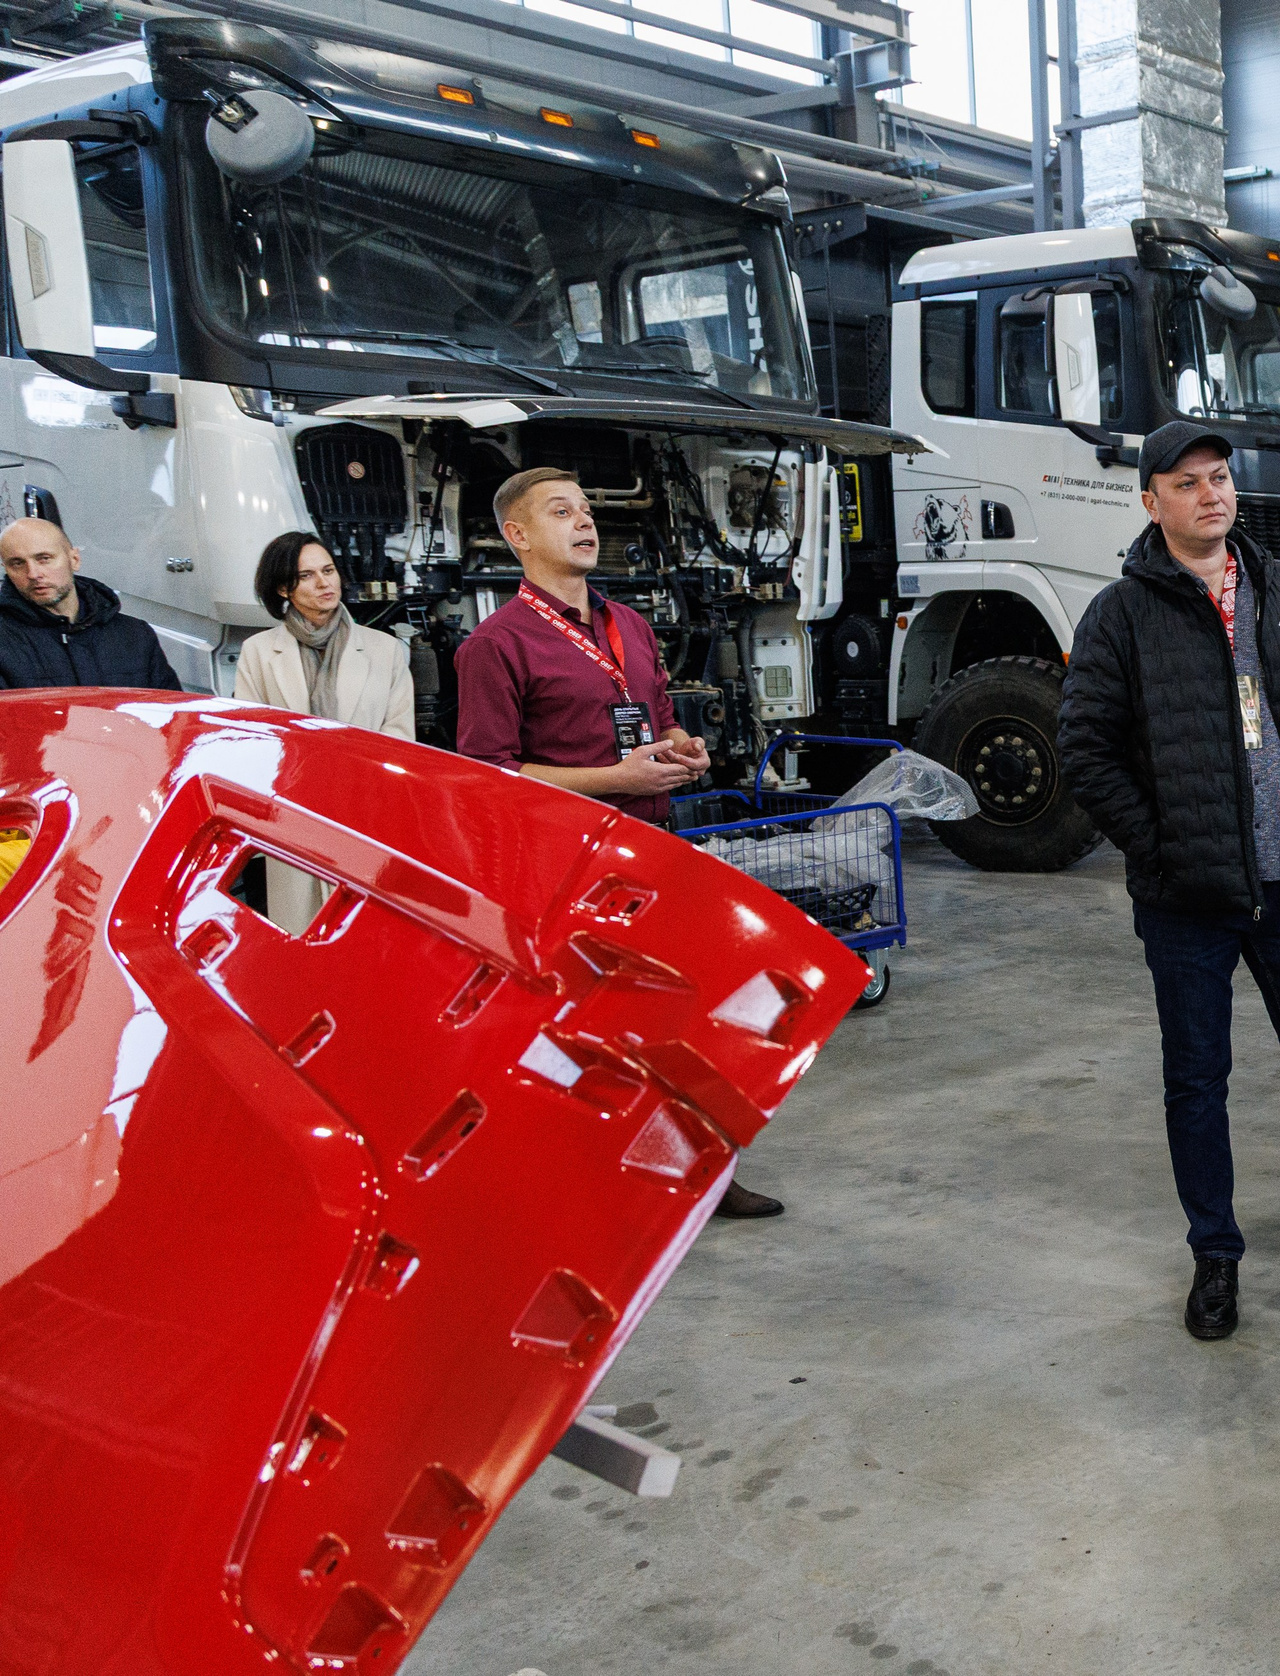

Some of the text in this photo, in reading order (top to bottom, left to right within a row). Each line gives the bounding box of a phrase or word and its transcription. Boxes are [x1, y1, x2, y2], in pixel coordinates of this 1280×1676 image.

[1063, 476, 1090, 488] ТЕХНИКА
[1090, 480, 1105, 490] ДЛЯ
[1105, 482, 1134, 493] БИЗНЕСА
[1061, 493, 1086, 503] 2-000-000
[1090, 497, 1130, 508] agat-technic.ru
